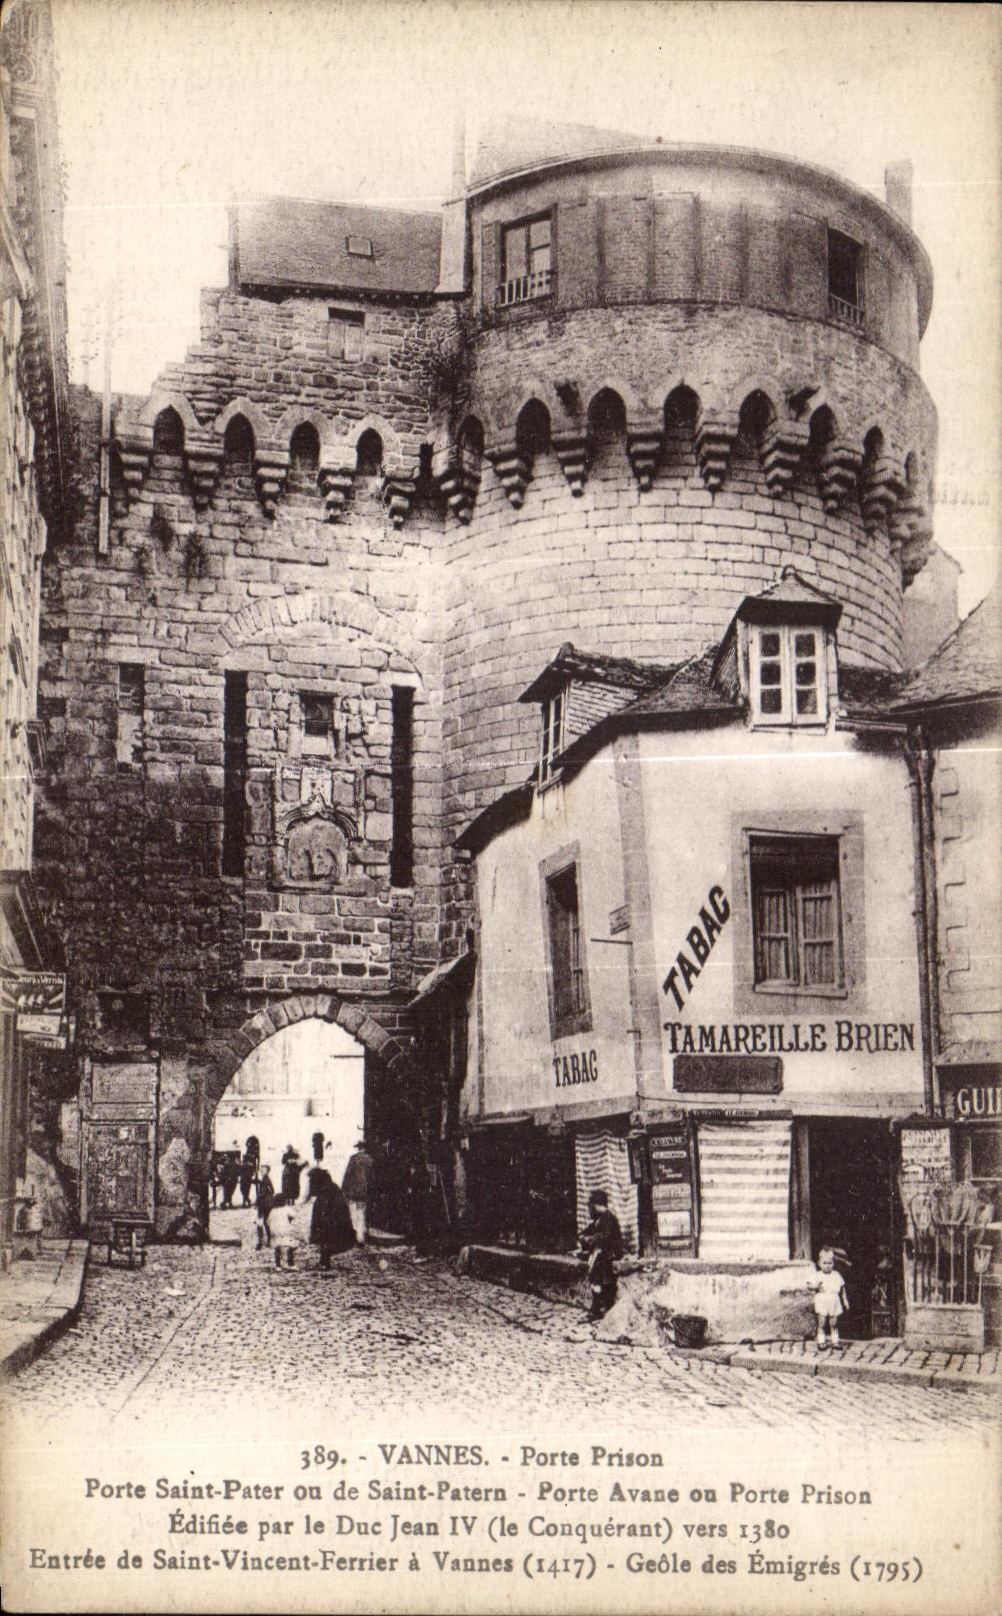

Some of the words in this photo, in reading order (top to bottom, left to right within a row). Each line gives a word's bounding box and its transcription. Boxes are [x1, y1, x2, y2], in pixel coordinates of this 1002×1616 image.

[662, 883, 731, 1013] TABAC
[663, 1021, 826, 1055] TAMAREILLE
[835, 1020, 914, 1053] BRIEN
[552, 1049, 598, 1088] TABAC
